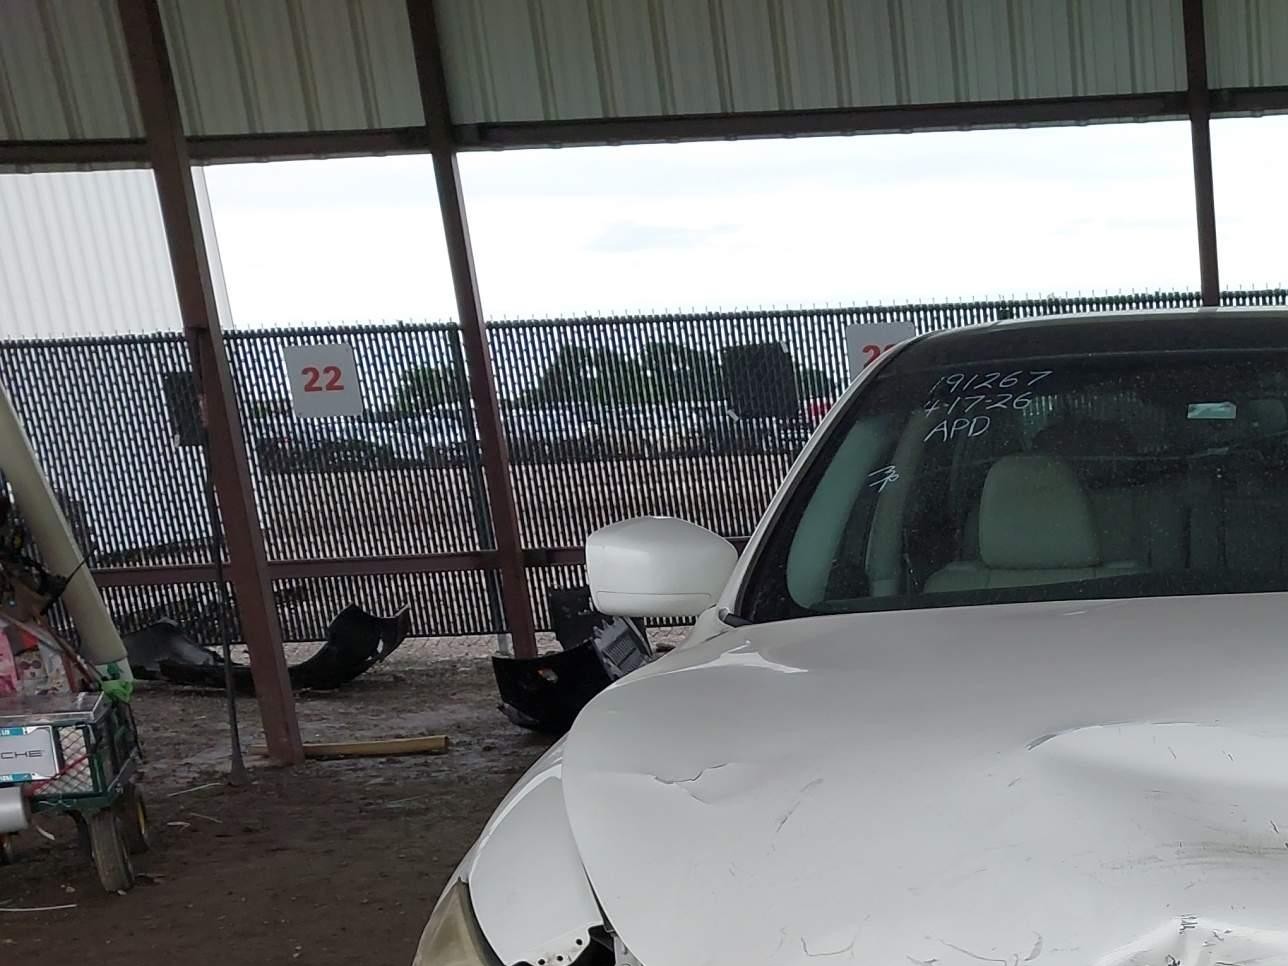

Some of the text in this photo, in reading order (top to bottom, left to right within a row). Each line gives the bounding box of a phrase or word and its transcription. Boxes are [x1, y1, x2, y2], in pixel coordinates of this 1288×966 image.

[301, 365, 345, 392] 22
[929, 370, 1053, 393] 191267
[923, 415, 991, 442] APD
